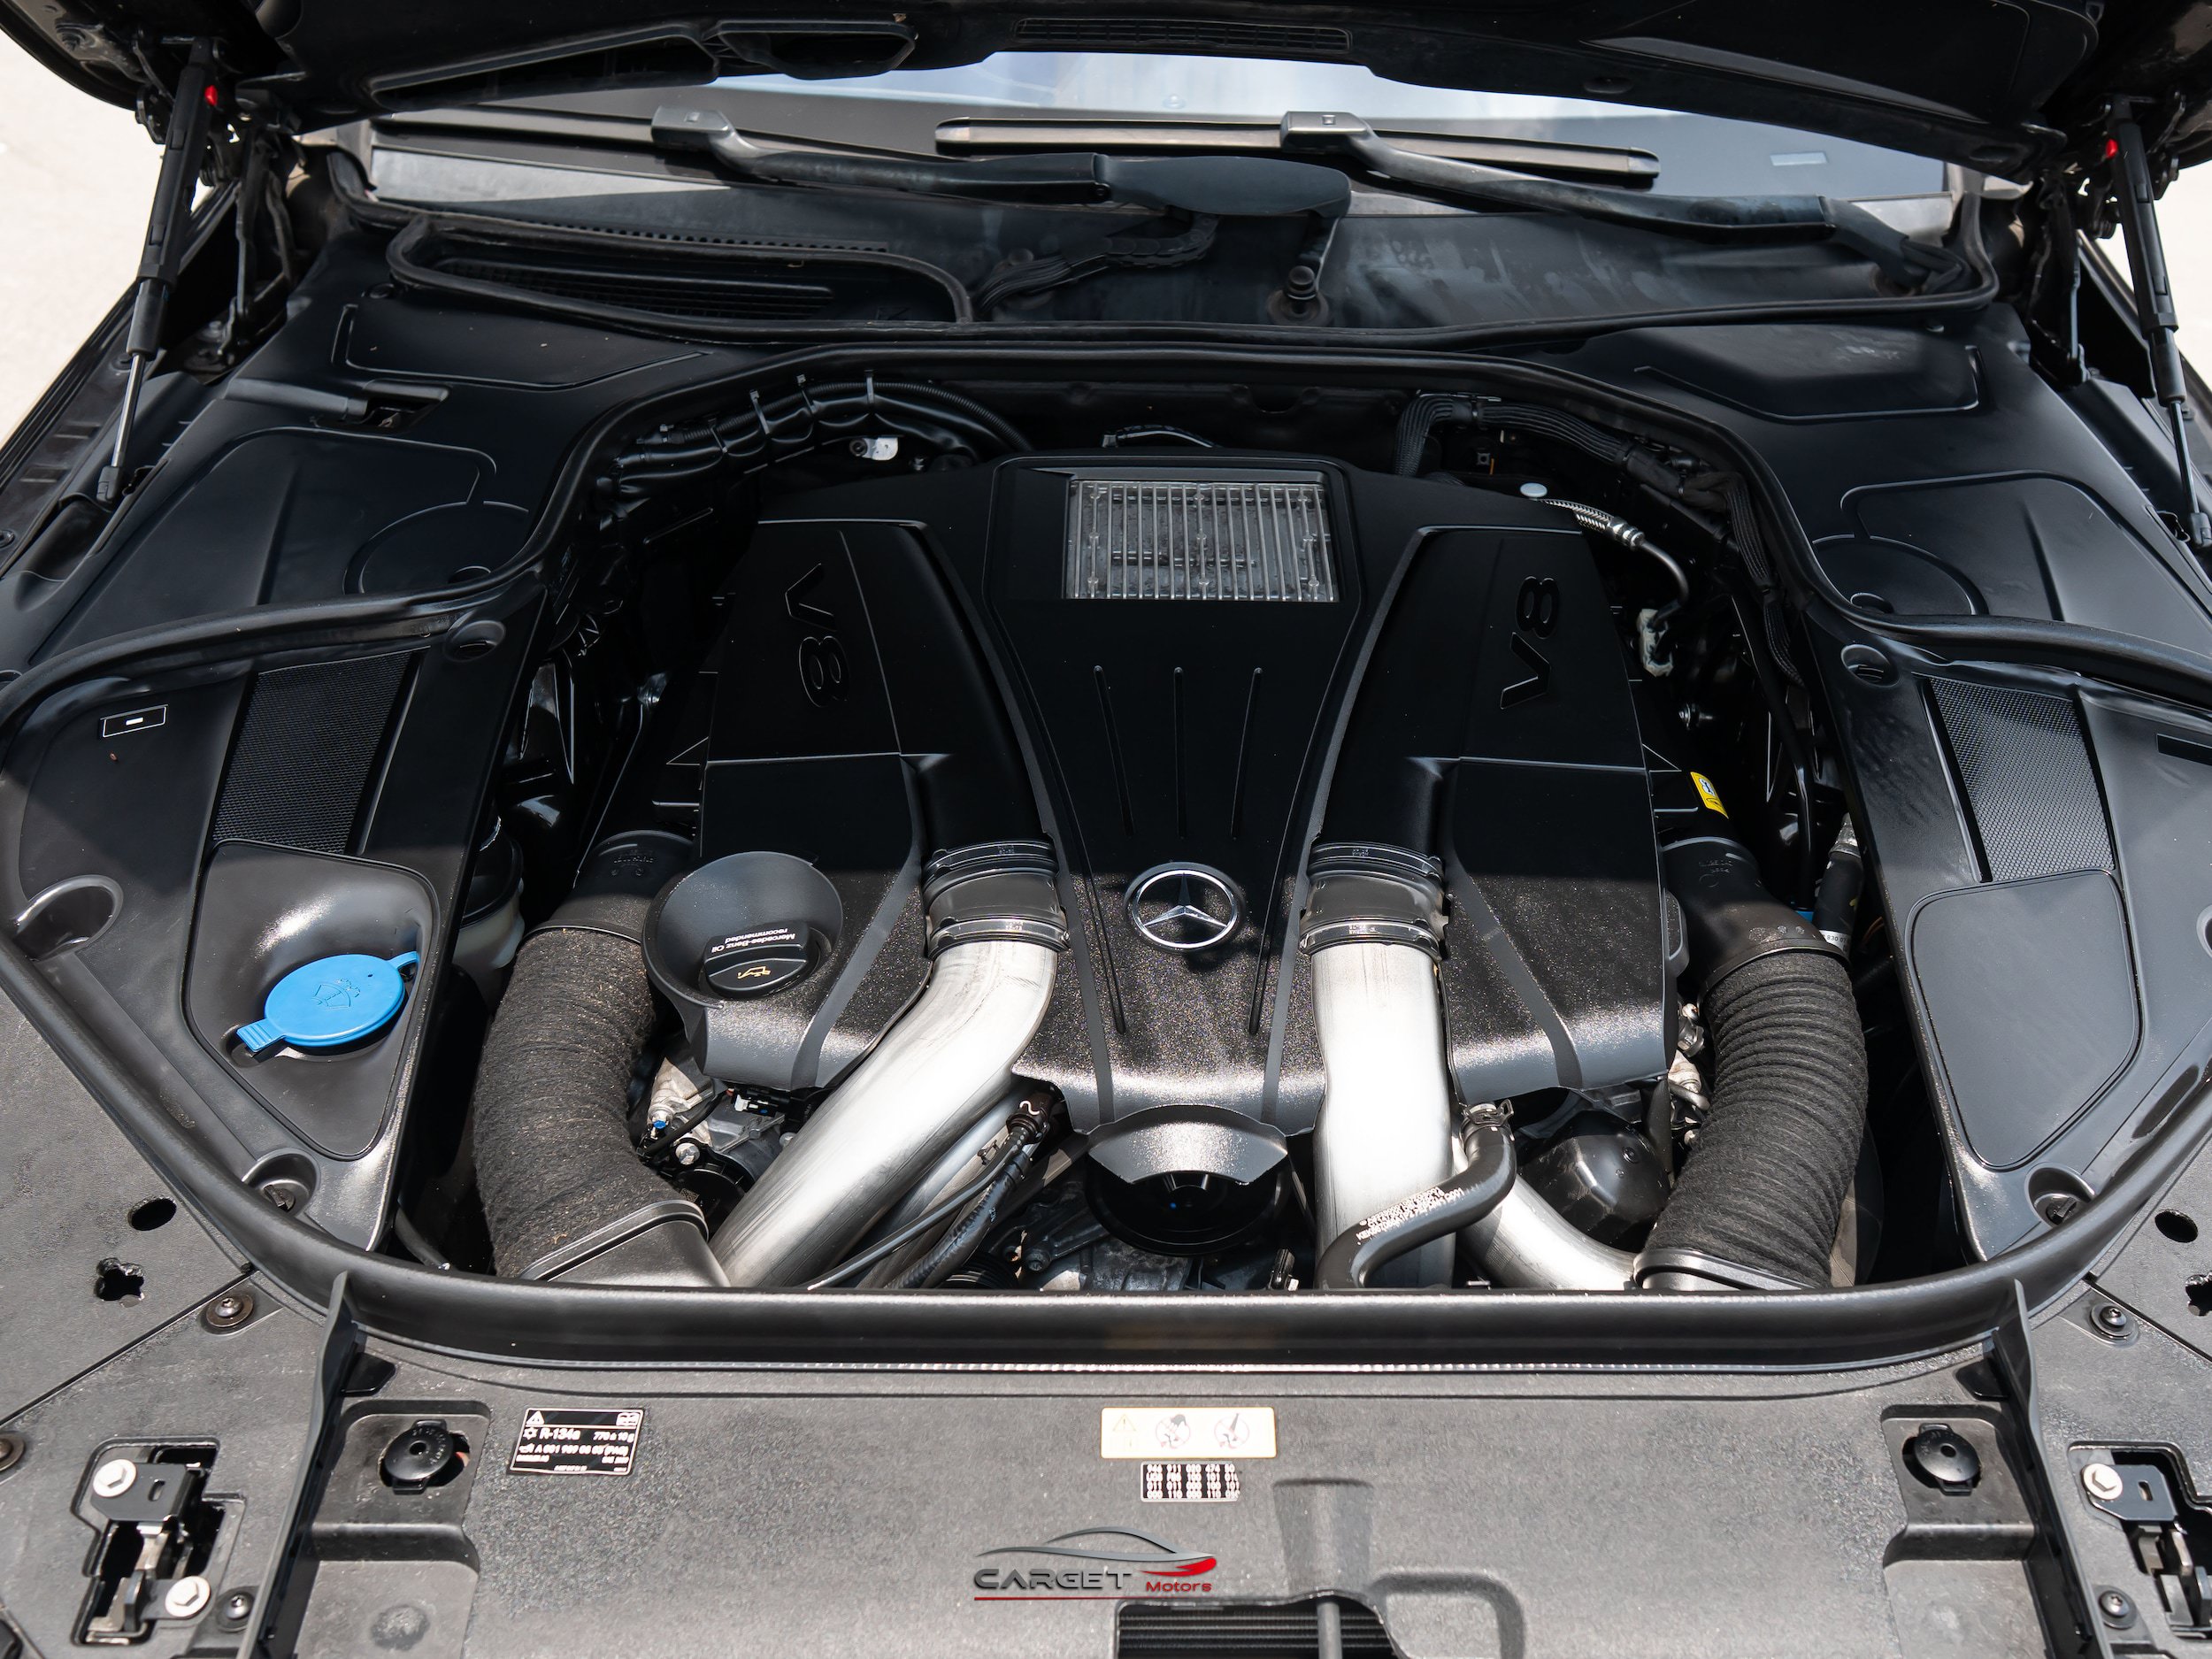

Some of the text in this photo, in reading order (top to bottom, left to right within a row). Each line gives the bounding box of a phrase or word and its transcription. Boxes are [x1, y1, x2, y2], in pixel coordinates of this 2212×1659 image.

[785, 562, 850, 708] V8
[1499, 575, 1560, 710] V8
[711, 933, 795, 953] Mercedes-Benz Oil
[725, 927, 788, 944] recommended
[539, 1427, 581, 1440] R-134a
